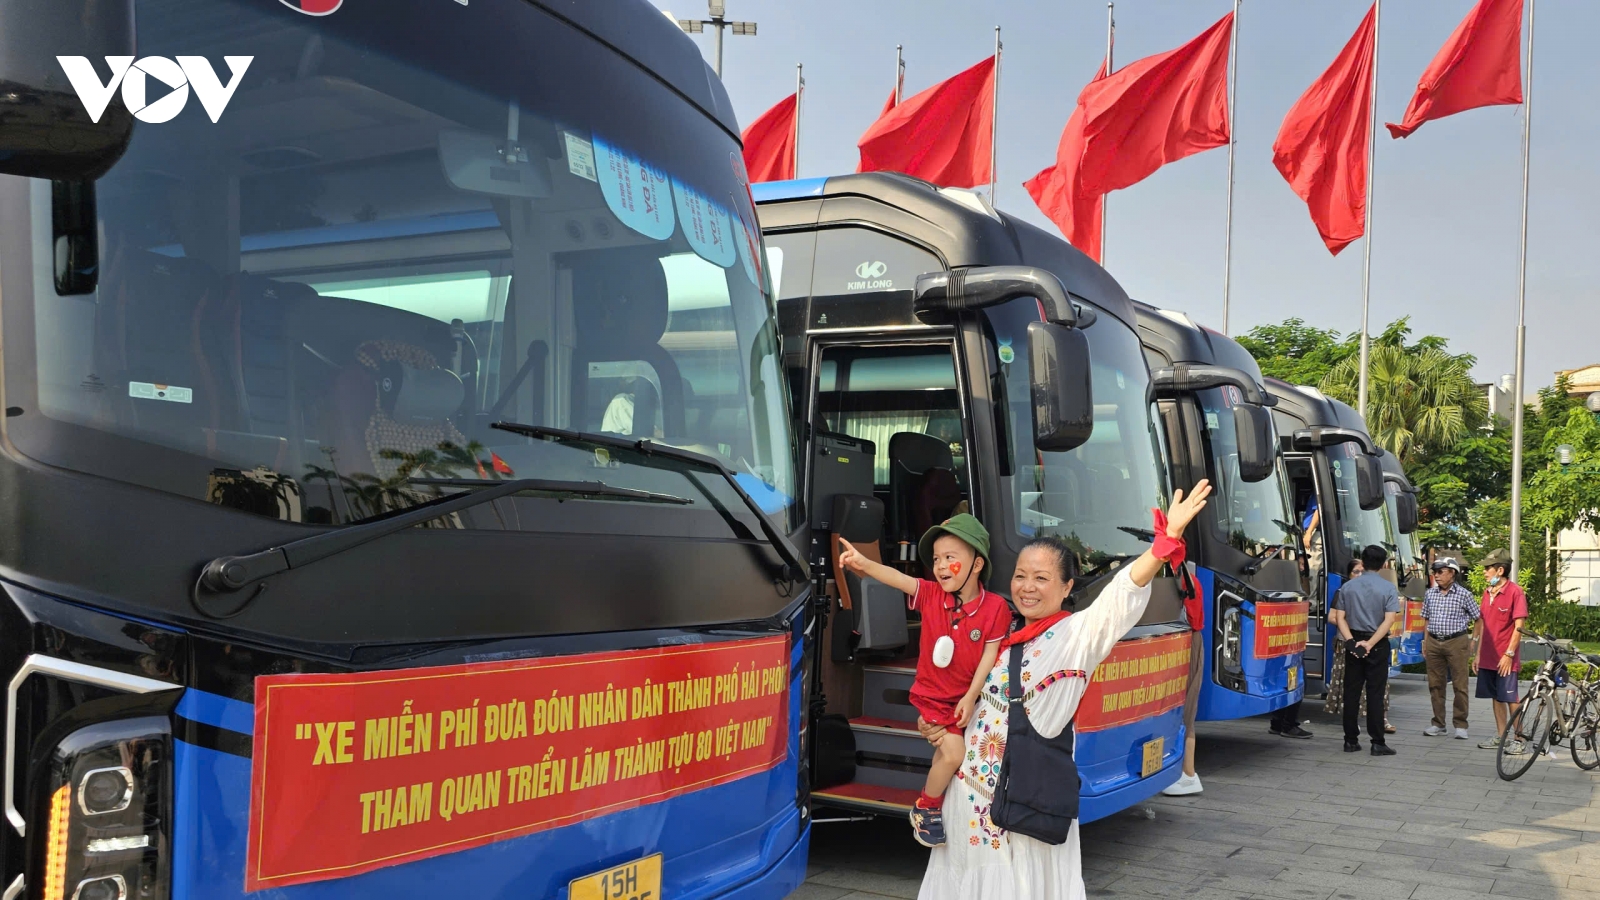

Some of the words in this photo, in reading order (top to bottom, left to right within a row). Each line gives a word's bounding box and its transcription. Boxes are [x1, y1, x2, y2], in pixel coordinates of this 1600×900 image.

[847, 281, 866, 290] KIM
[867, 280, 893, 289] LONG
[295, 721, 355, 765] "XE
[363, 699, 433, 761] MIỄN
[439, 698, 480, 750] PHÍ
[484, 698, 528, 743] ĐƯA
[533, 689, 574, 736] ĐÓN
[579, 682, 627, 729] NHÂN
[631, 678, 663, 720] DÂN
[667, 673, 712, 714] THÀNH
[714, 662, 739, 705] PHỐ
[741, 660, 760, 700] HẢI
[360, 782, 433, 834] THAM
[439, 769, 501, 822] QUAN
[507, 745, 566, 804] TRIỂN
[570, 746, 610, 791] LÃM
[614, 737, 665, 781] THÀNH
[668, 731, 694, 774] TỰU
[696, 729, 713, 762] 80
[715, 718, 740, 761] VIỆT
[741, 716, 772, 751] NAM"
[601, 864, 638, 900] 15H
